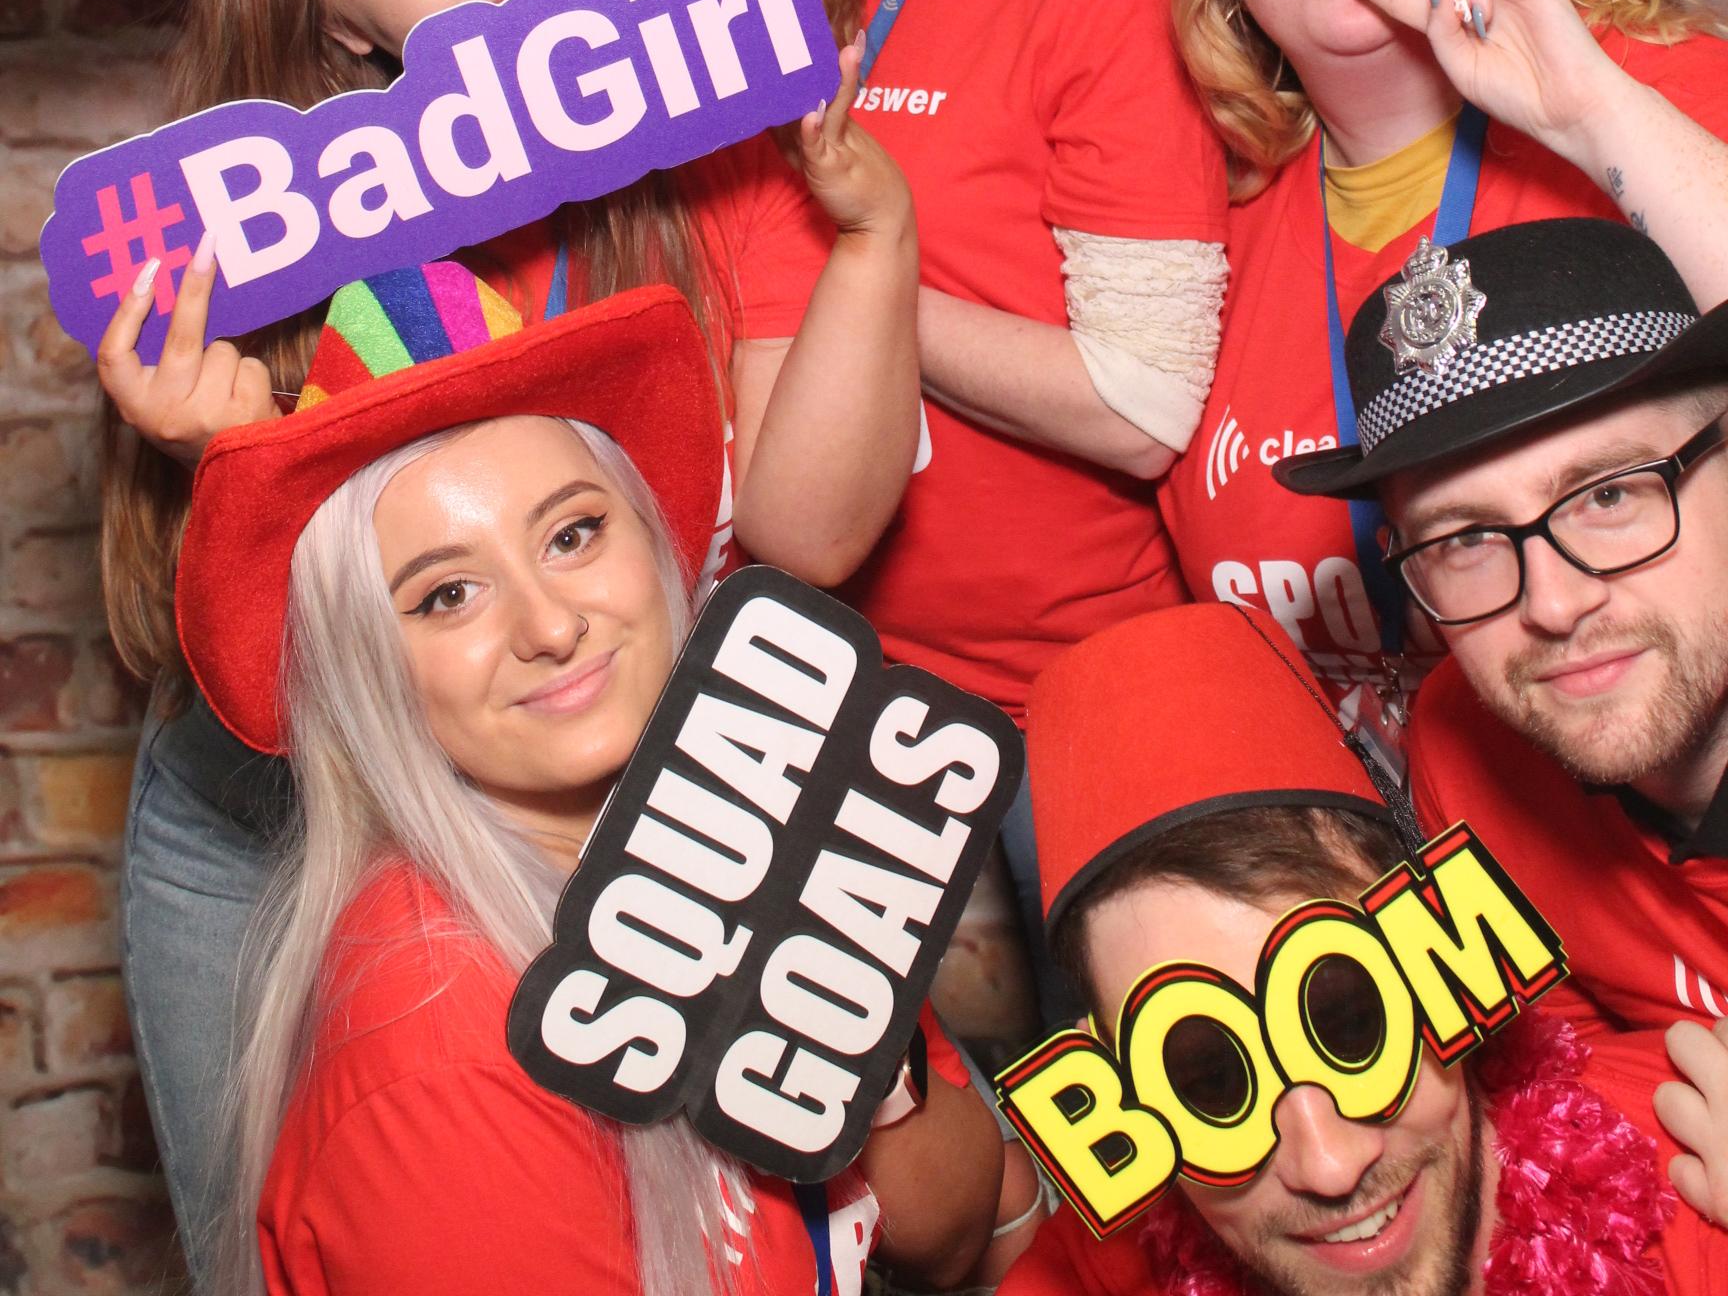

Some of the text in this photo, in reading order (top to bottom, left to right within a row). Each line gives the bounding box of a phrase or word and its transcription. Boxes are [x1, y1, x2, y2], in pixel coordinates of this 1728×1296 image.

[1259, 430, 1338, 466] clea
[540, 596, 858, 1092] SQUAD
[715, 695, 1001, 1153] GOALS
[1001, 836, 1565, 1230] BOOM
